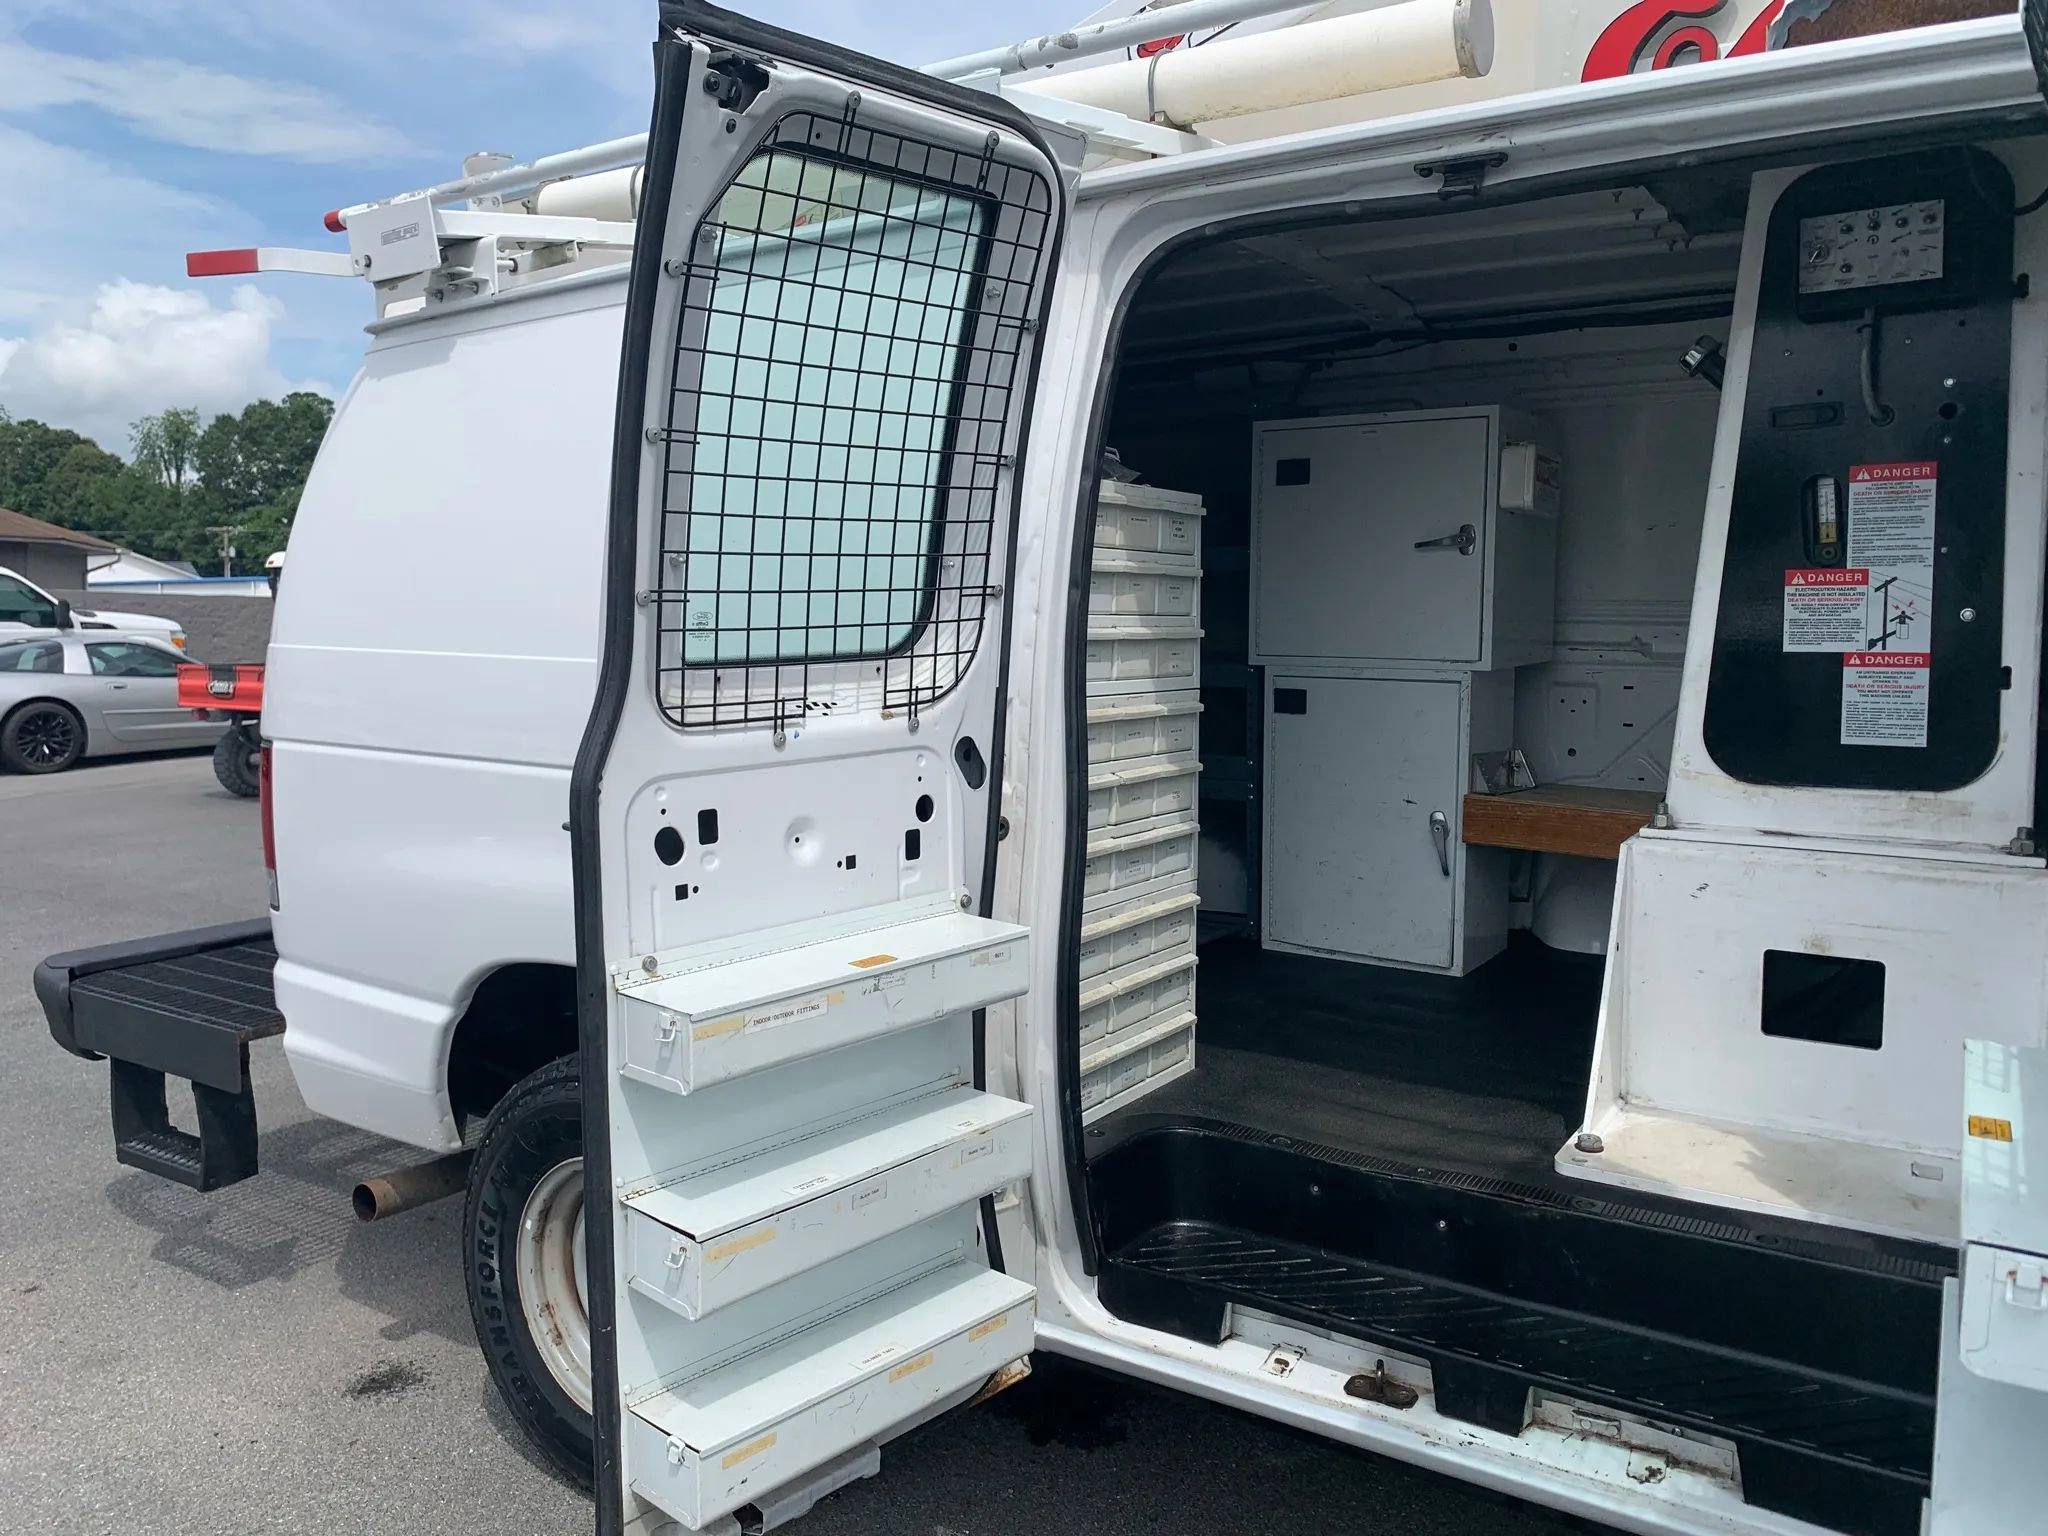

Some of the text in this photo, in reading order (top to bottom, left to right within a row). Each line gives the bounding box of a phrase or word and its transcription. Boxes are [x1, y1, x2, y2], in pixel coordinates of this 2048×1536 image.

[1873, 467, 1930, 478] DANGER
[1808, 573, 1862, 582] DANGER
[1865, 656, 1923, 665] DANGER
[753, 1003, 820, 1026] INDOOR/OUTDOOR FITTINGS
[477, 1199, 541, 1411] TRANSFORCE
